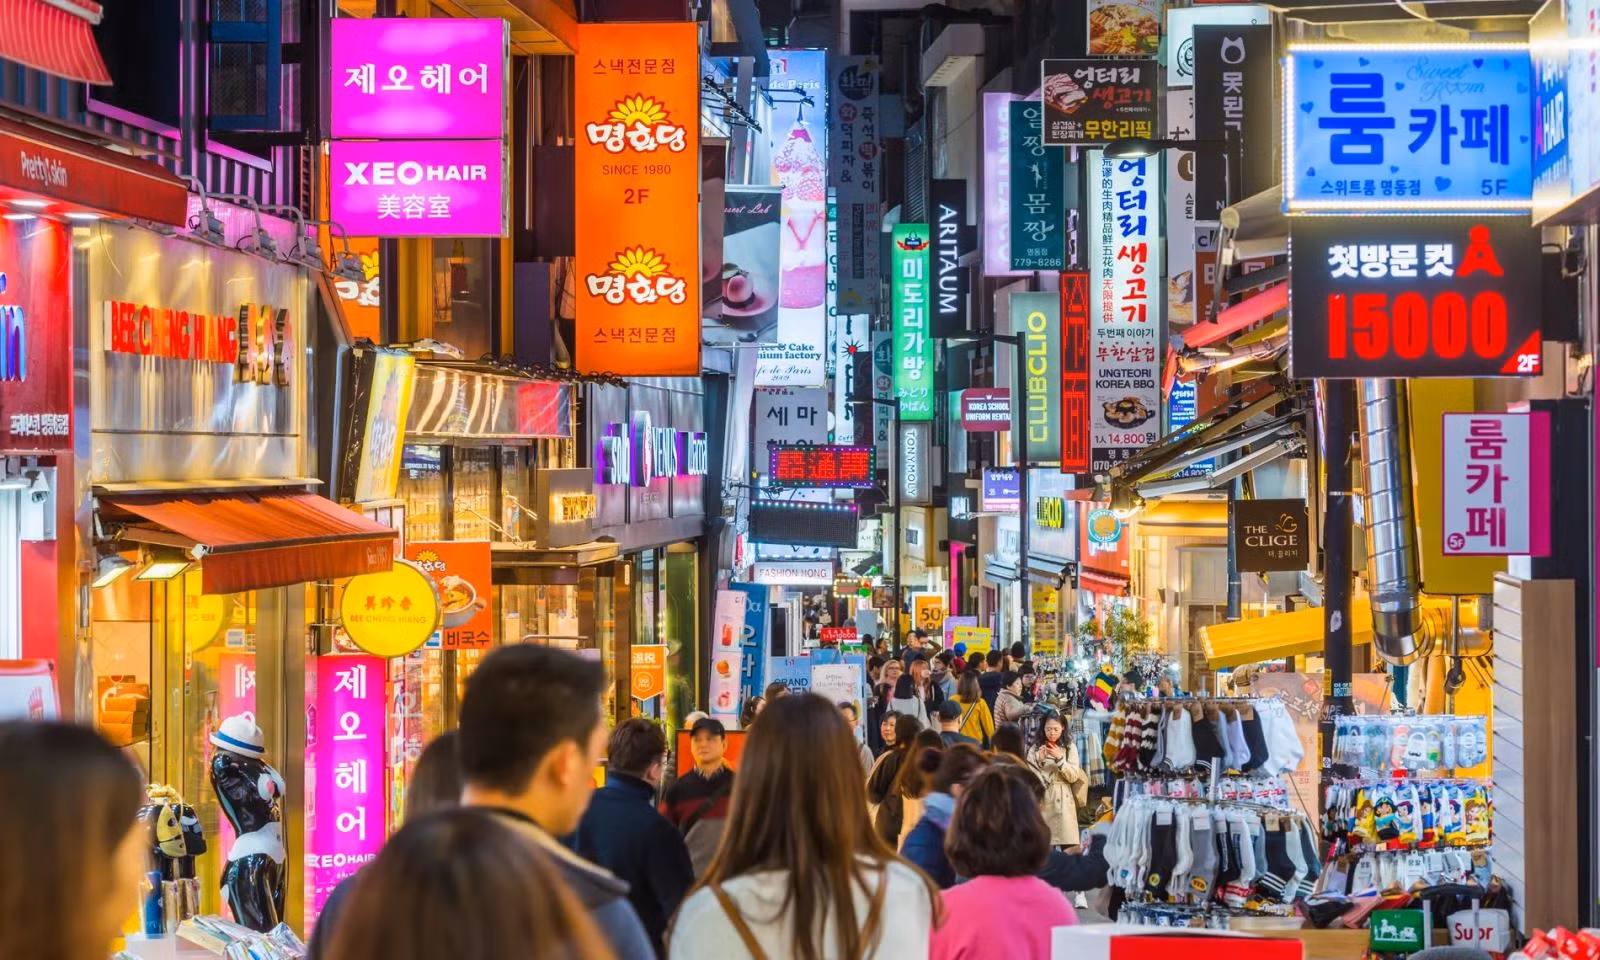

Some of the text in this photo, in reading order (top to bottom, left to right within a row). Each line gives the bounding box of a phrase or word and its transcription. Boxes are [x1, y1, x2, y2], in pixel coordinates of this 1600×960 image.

[592, 58, 676, 75] 스낵전문점
[343, 63, 489, 95] 제오헤어
[1074, 67, 1140, 88] 엉터리
[1092, 86, 1151, 109] 생고기
[586, 121, 687, 153] 명화당
[1085, 120, 1152, 139] 무한리필
[602, 165, 671, 175] SINCE 1980
[623, 188, 650, 205] 2F
[1320, 179, 1421, 196] 스위트룸 명동점
[1481, 179, 1509, 196] 5F
[377, 194, 451, 219] 美容室
[1115, 157, 1147, 238] 엉터리
[1022, 194, 1055, 242] 몸짱
[938, 204, 958, 313] ARITAUM
[1014, 258, 1062, 267] 779-8286
[1328, 243, 1454, 279] 첫방문 컷
[586, 272, 687, 305] 명화당
[1116, 243, 1147, 323] 생고기
[903, 257, 924, 381] 미도리가방
[1327, 290, 1508, 361] 15000
[593, 327, 676, 343] 스낵전문점
[1097, 328, 1154, 339] 두번째 이야기
[785, 351, 821, 361] factory
[1517, 354, 1539, 373] 2F
[1098, 369, 1152, 378] UNGTEORI
[1095, 379, 1155, 389] KOREA BBQ
[988, 402, 1010, 410] SCHOOL
[904, 430, 916, 497] TONYMOLY
[1243, 525, 1267, 533] THE
[1245, 535, 1298, 547] CLIGE
[759, 568, 827, 578] FASHION HONG
[332, 664, 367, 840] 제오헤어
